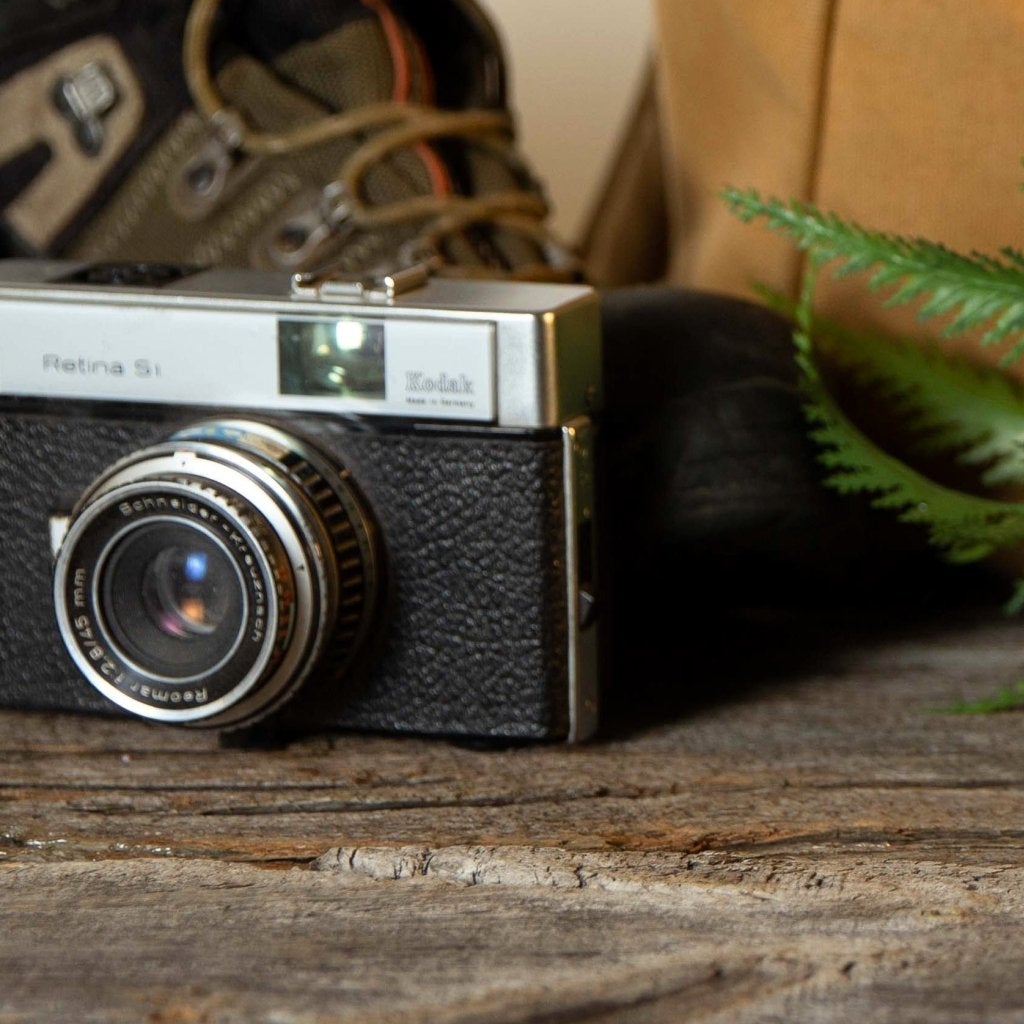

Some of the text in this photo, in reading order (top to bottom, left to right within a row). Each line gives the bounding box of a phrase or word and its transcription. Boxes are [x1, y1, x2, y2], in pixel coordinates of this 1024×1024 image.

[42, 352, 125, 378] Retina
[404, 370, 475, 393] Kodak
[73, 567, 88, 608] mm
[129, 681, 209, 703] Reomar
